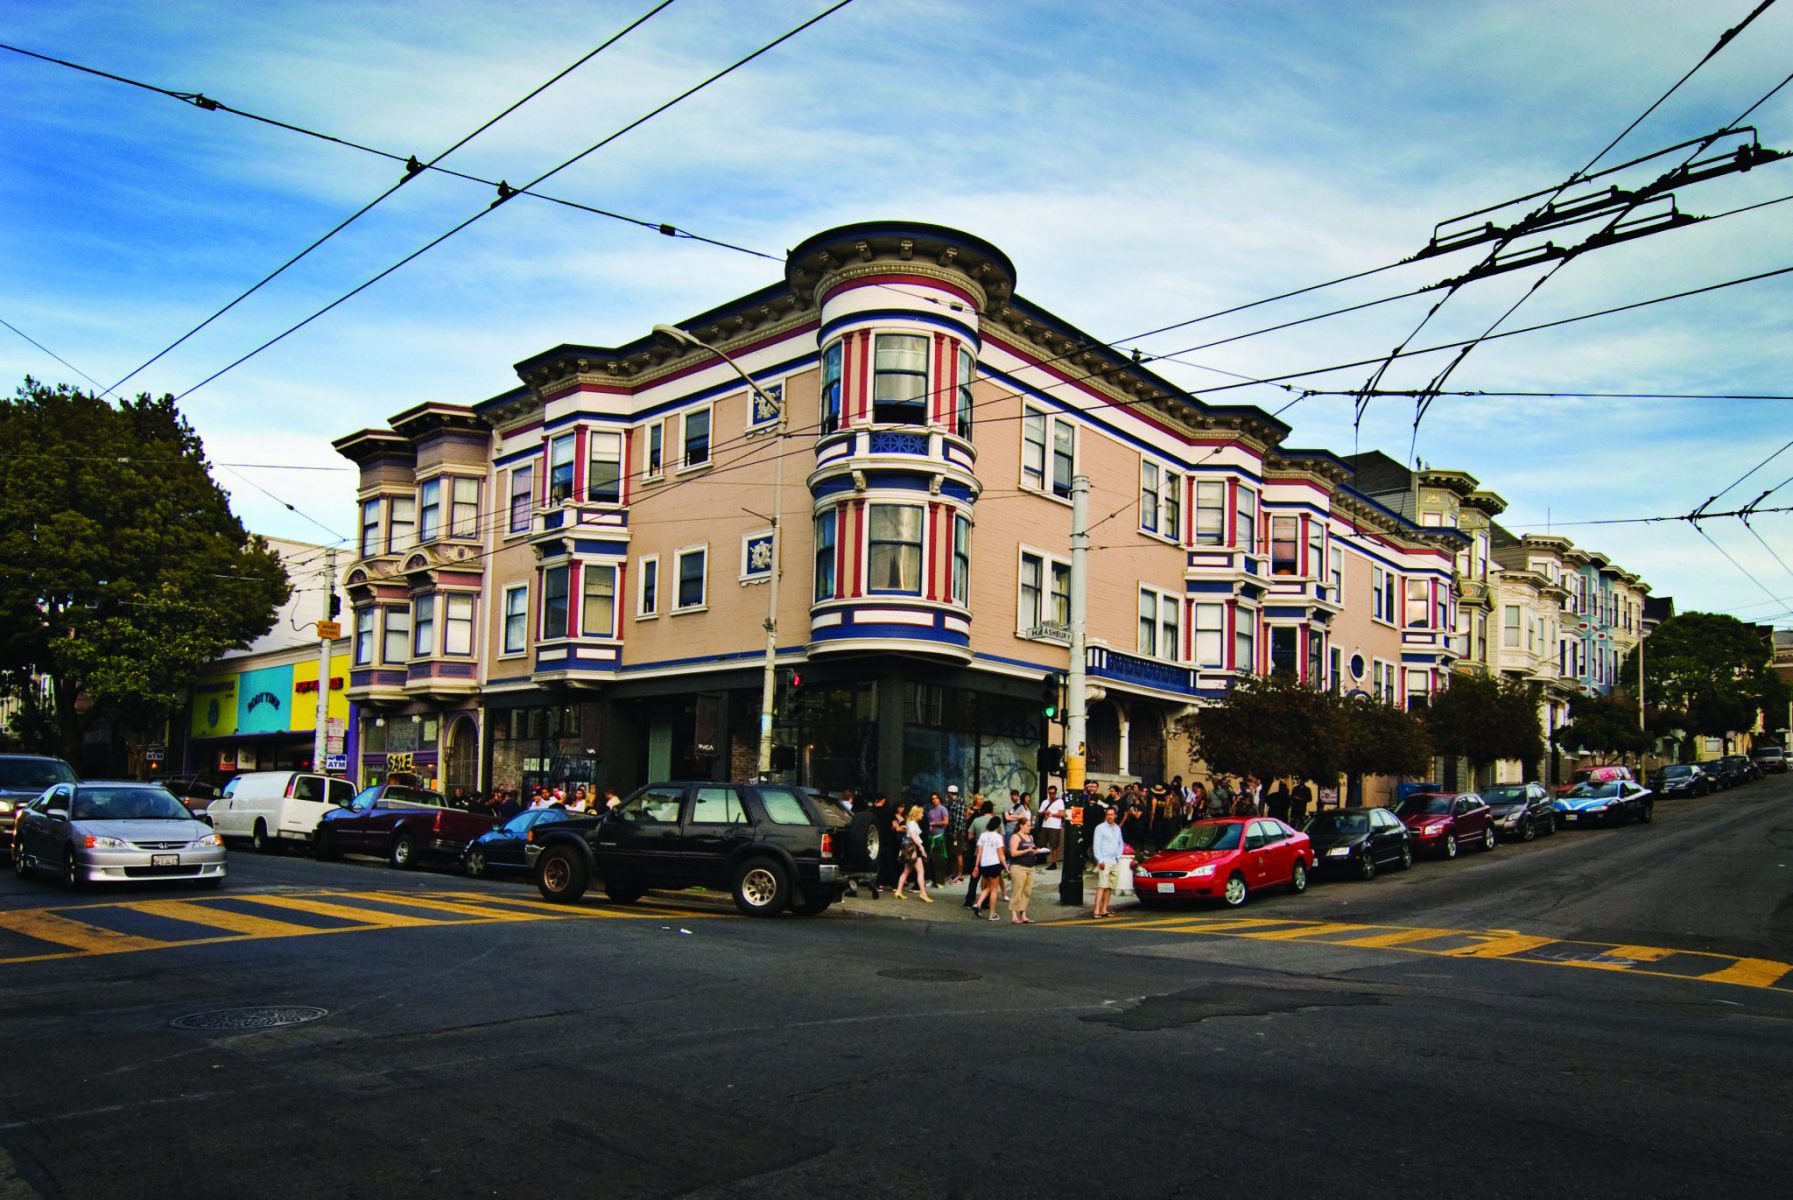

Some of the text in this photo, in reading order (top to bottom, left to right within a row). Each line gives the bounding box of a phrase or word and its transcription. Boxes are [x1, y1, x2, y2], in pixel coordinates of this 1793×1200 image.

[1044, 628, 1070, 640] ASHBURY
[248, 692, 264, 713] BODY
[387, 754, 412, 772] SALE
